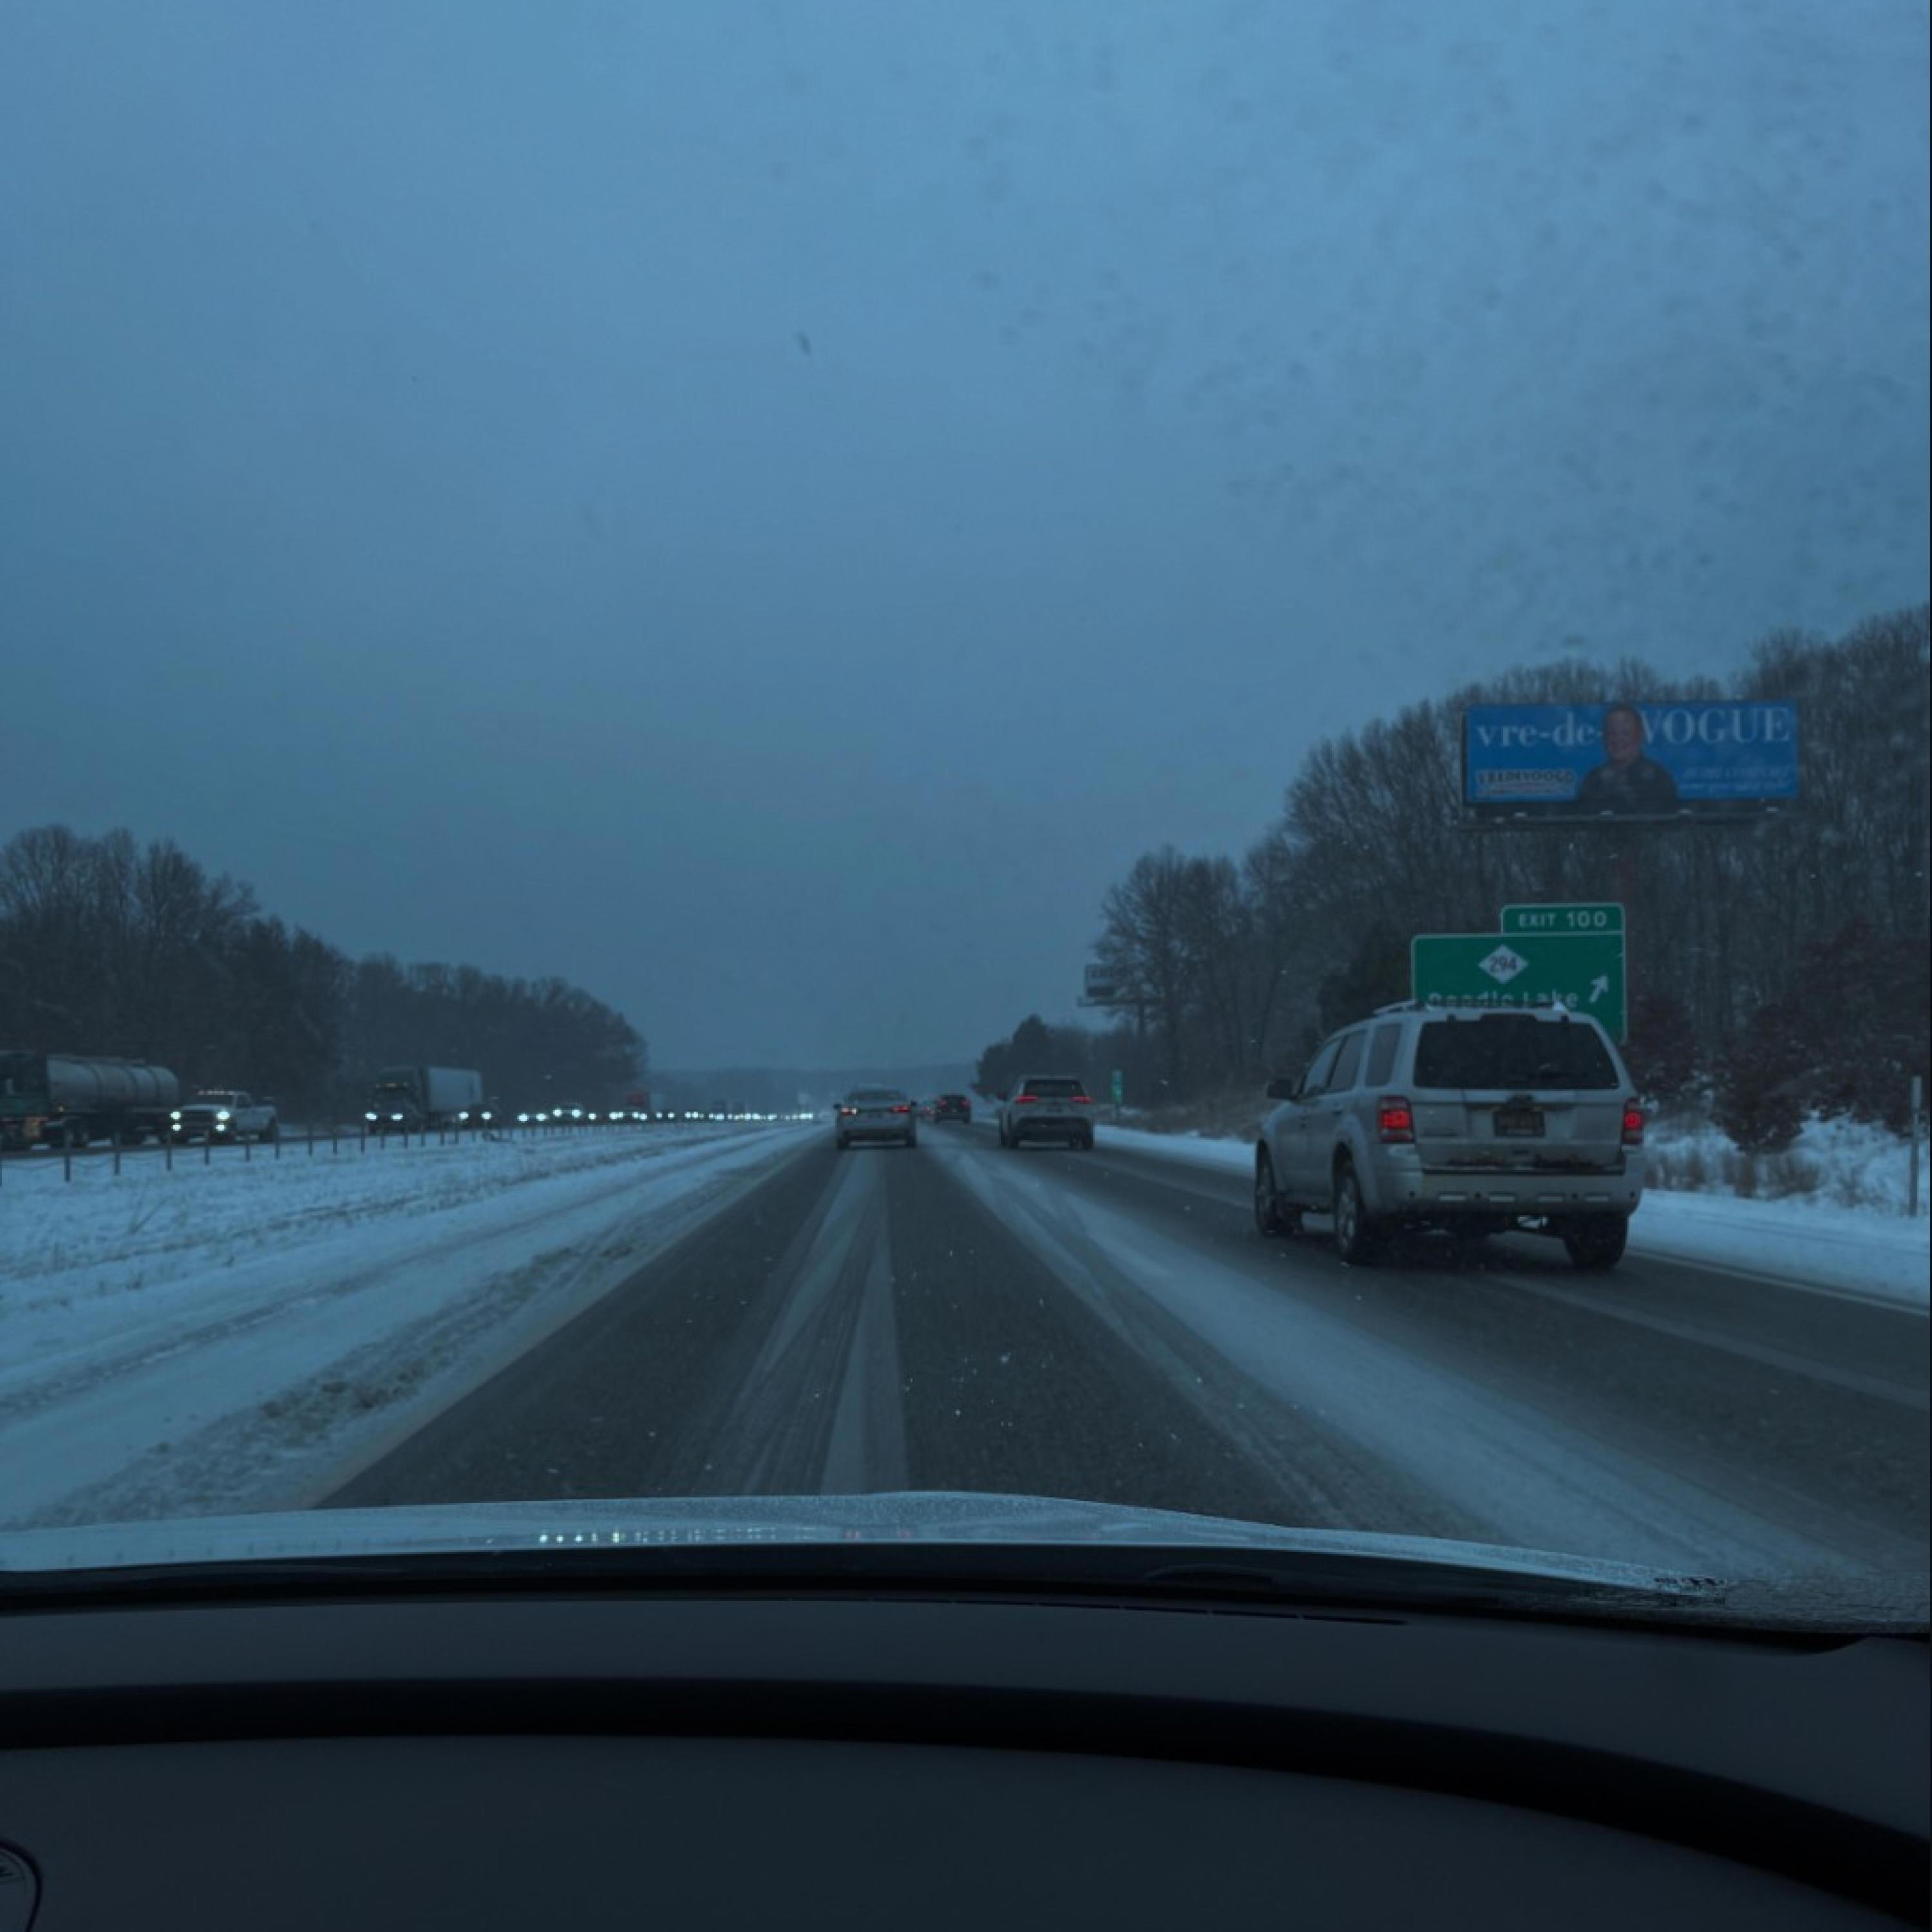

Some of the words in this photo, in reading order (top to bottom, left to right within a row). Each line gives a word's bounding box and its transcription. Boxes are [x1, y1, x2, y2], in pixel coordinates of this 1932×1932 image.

[1640, 707, 1792, 743] VOGUE
[1518, 912, 1557, 928] EXIT
[1566, 910, 1607, 928] 100
[1489, 955, 1517, 972] 294
